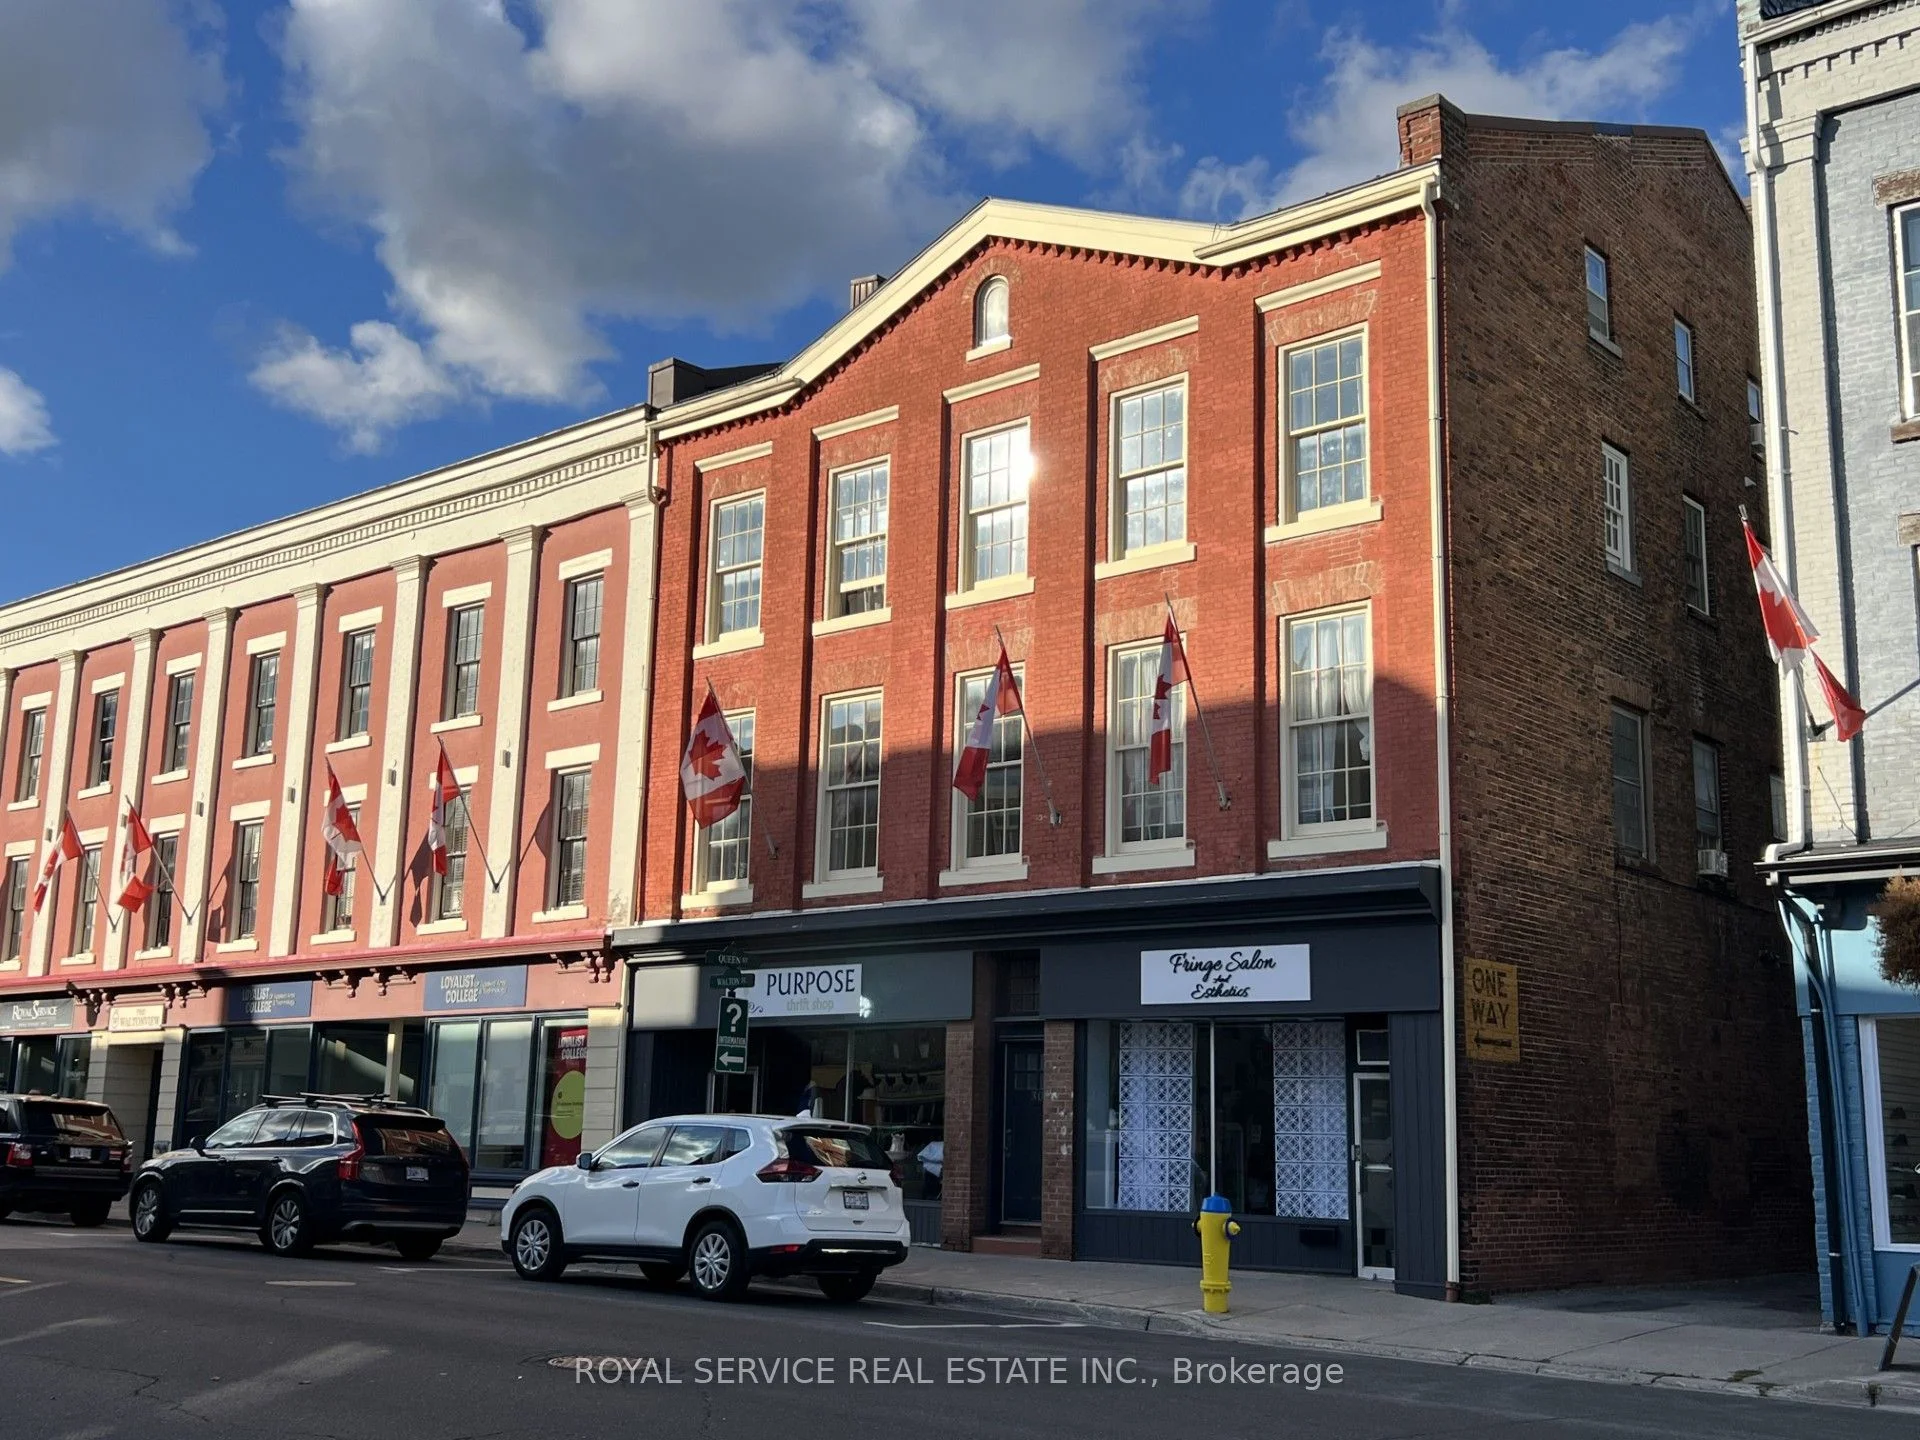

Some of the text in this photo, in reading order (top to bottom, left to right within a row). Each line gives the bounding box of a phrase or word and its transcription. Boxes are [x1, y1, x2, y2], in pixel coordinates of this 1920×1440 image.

[718, 955, 741, 964] QUEEN
[1169, 949, 1277, 983] Fringe Salon
[441, 974, 476, 990] LOYALIST
[716, 978, 741, 986] WALTON
[766, 968, 856, 996] PURPOSE
[1472, 967, 1508, 998] ONE
[445, 988, 478, 1004] COLLEGE
[1190, 983, 1251, 1000] Esthetics
[245, 1000, 272, 1014] COLLEGE
[787, 997, 834, 1012] thrift shop
[1471, 998, 1510, 1029] WAY
[558, 1035, 585, 1049] LOYALIST
[719, 1036, 746, 1045] INFORMATION
